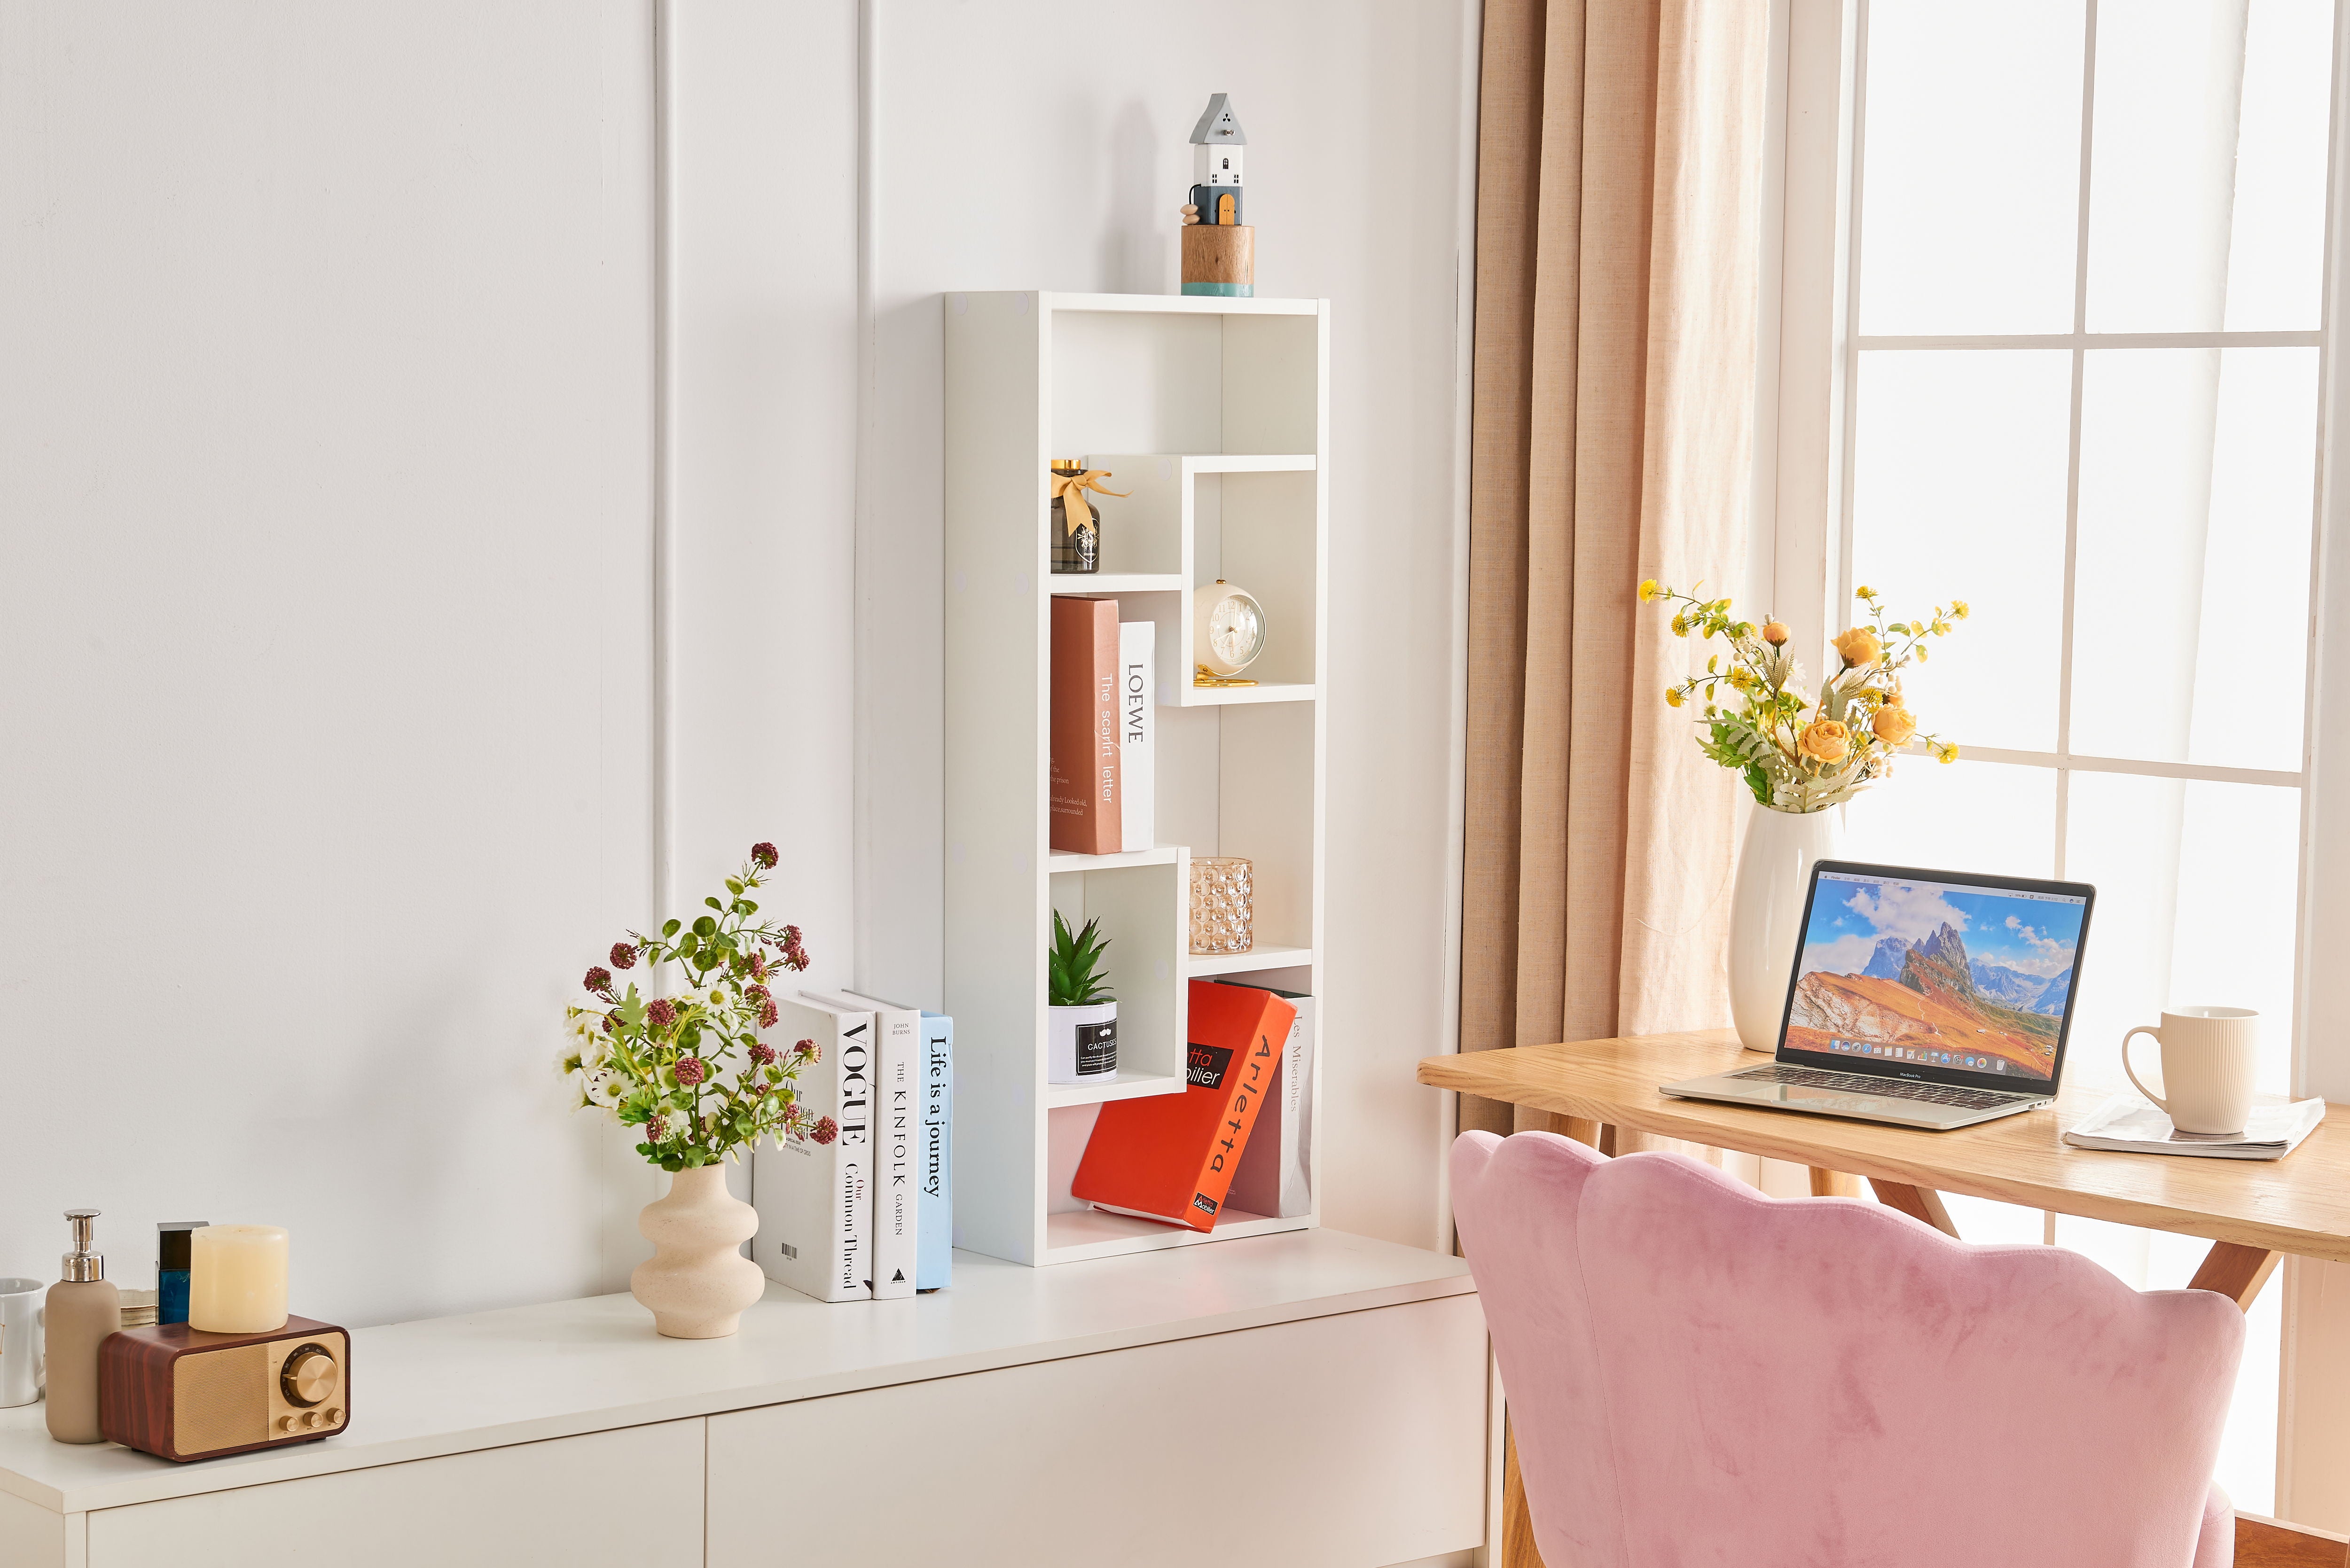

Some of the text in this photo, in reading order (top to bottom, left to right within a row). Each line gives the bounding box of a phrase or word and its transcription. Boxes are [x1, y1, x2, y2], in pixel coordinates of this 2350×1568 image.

[1227, 601, 1235, 609] 12
[1101, 673, 1114, 803] The scarlrt letter
[1128, 663, 1143, 743] LOEWE
[1050, 795, 1064, 804] already
[1065, 797, 1079, 805] Looked
[842, 1020, 867, 1146] VOGUE
[1088, 1038, 1117, 1051] CACTUSES
[1187, 1048, 1213, 1067] tta
[1291, 1015, 1303, 1112] Les Miserables
[893, 1090, 906, 1187] KINFOLK
[924, 1036, 947, 1198] Life is a journey
[1210, 1035, 1270, 1173] Arletta
[843, 1163, 859, 1289] Common Thread
[855, 1179, 865, 1200] Our
[1194, 1200, 1214, 1214] Mobilier
[1198, 1195, 1214, 1207] Arletta
